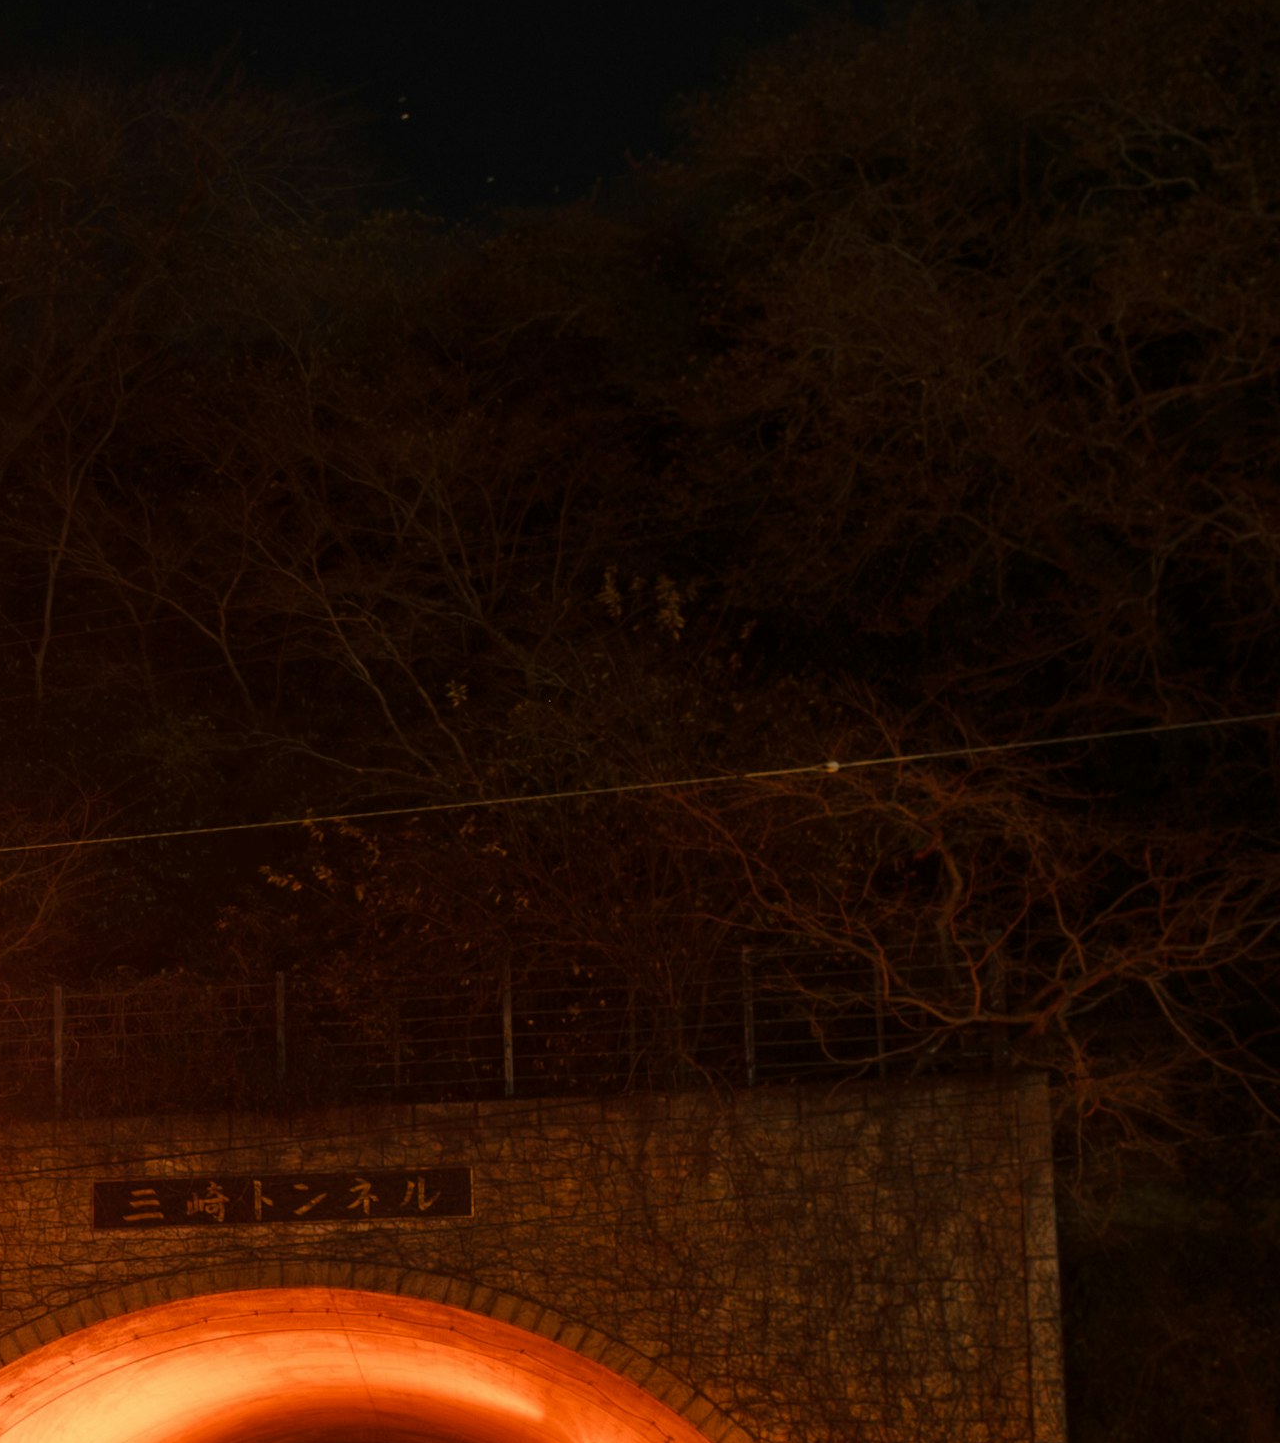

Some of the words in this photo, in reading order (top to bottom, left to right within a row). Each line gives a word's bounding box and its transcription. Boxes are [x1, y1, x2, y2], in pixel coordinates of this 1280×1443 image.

[123, 1178, 440, 1222] 三崎トンネル
